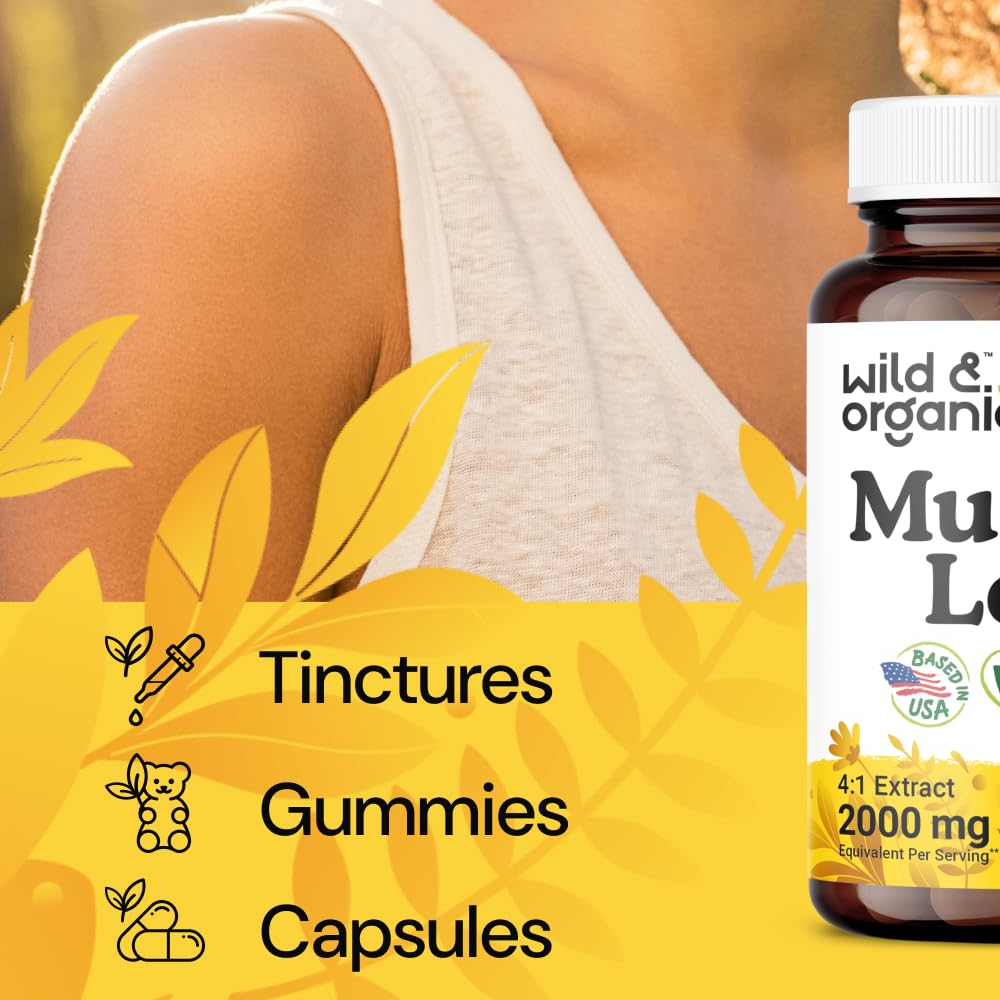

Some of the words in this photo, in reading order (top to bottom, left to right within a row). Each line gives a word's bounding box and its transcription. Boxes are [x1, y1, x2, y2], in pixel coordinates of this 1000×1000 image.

[842, 352, 934, 394] wild
[911, 649, 963, 684] BASED
[956, 685, 969, 701] IN
[909, 698, 950, 721] USA
[837, 775, 866, 796] 4:1
[874, 775, 956, 799] Extract
[837, 804, 922, 839] 2000
[931, 814, 990, 848] mg
[838, 844, 904, 861] Equivalent
[908, 848, 931, 862] Per
